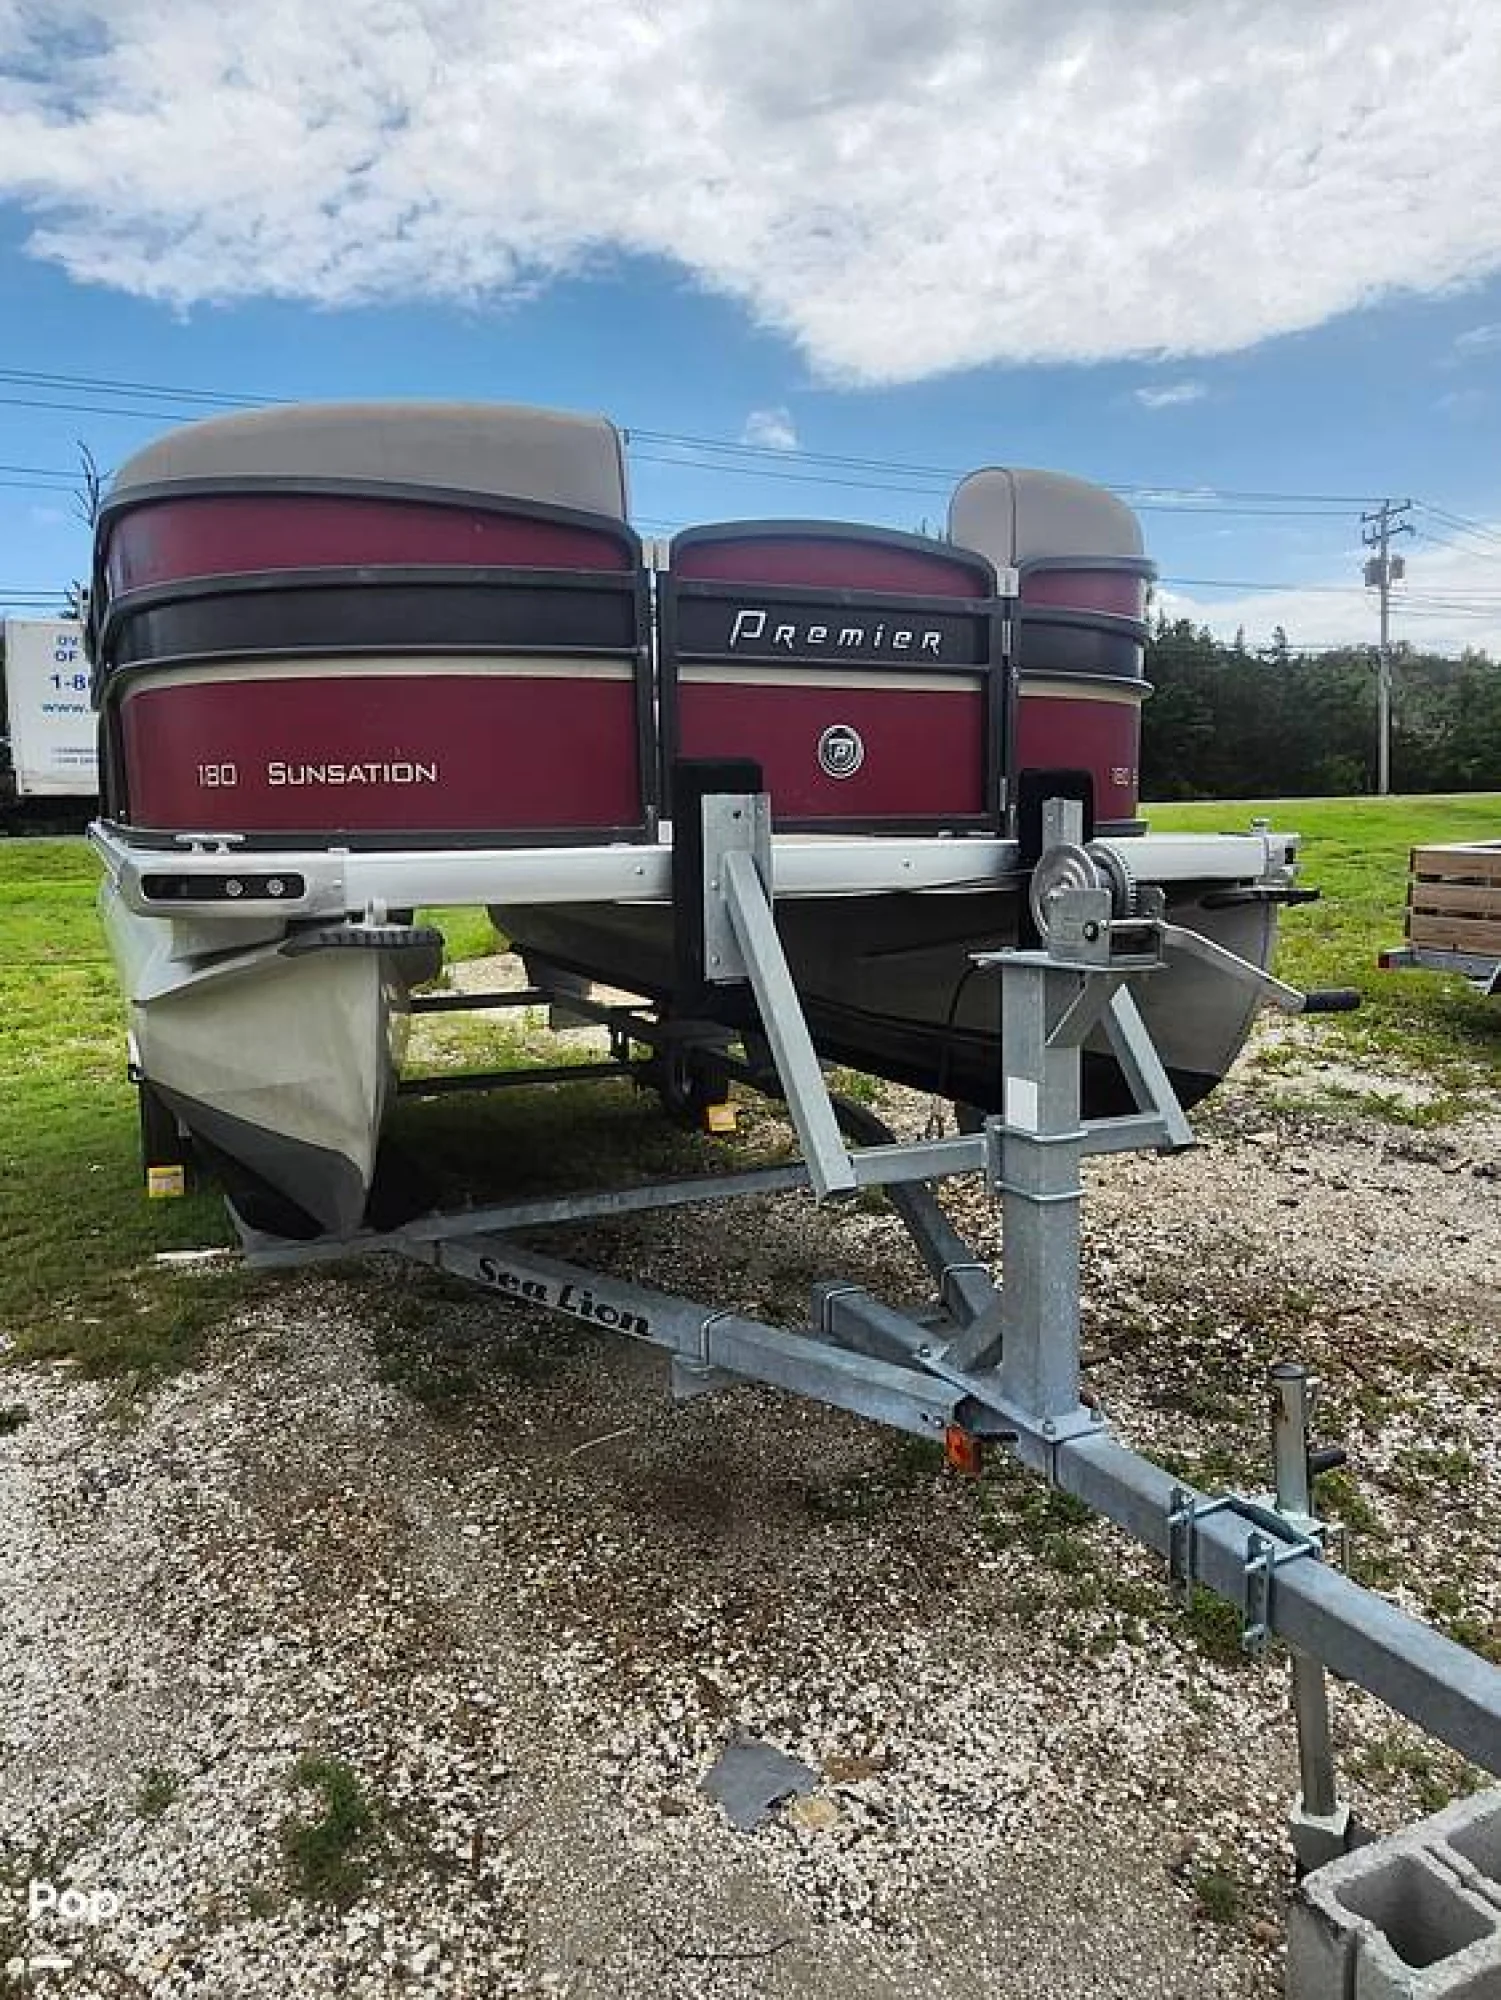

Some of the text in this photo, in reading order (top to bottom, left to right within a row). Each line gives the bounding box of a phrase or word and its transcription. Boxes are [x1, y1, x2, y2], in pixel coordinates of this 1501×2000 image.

[198, 763, 238, 787] 180
[475, 1257, 654, 1337] Sea Lion
